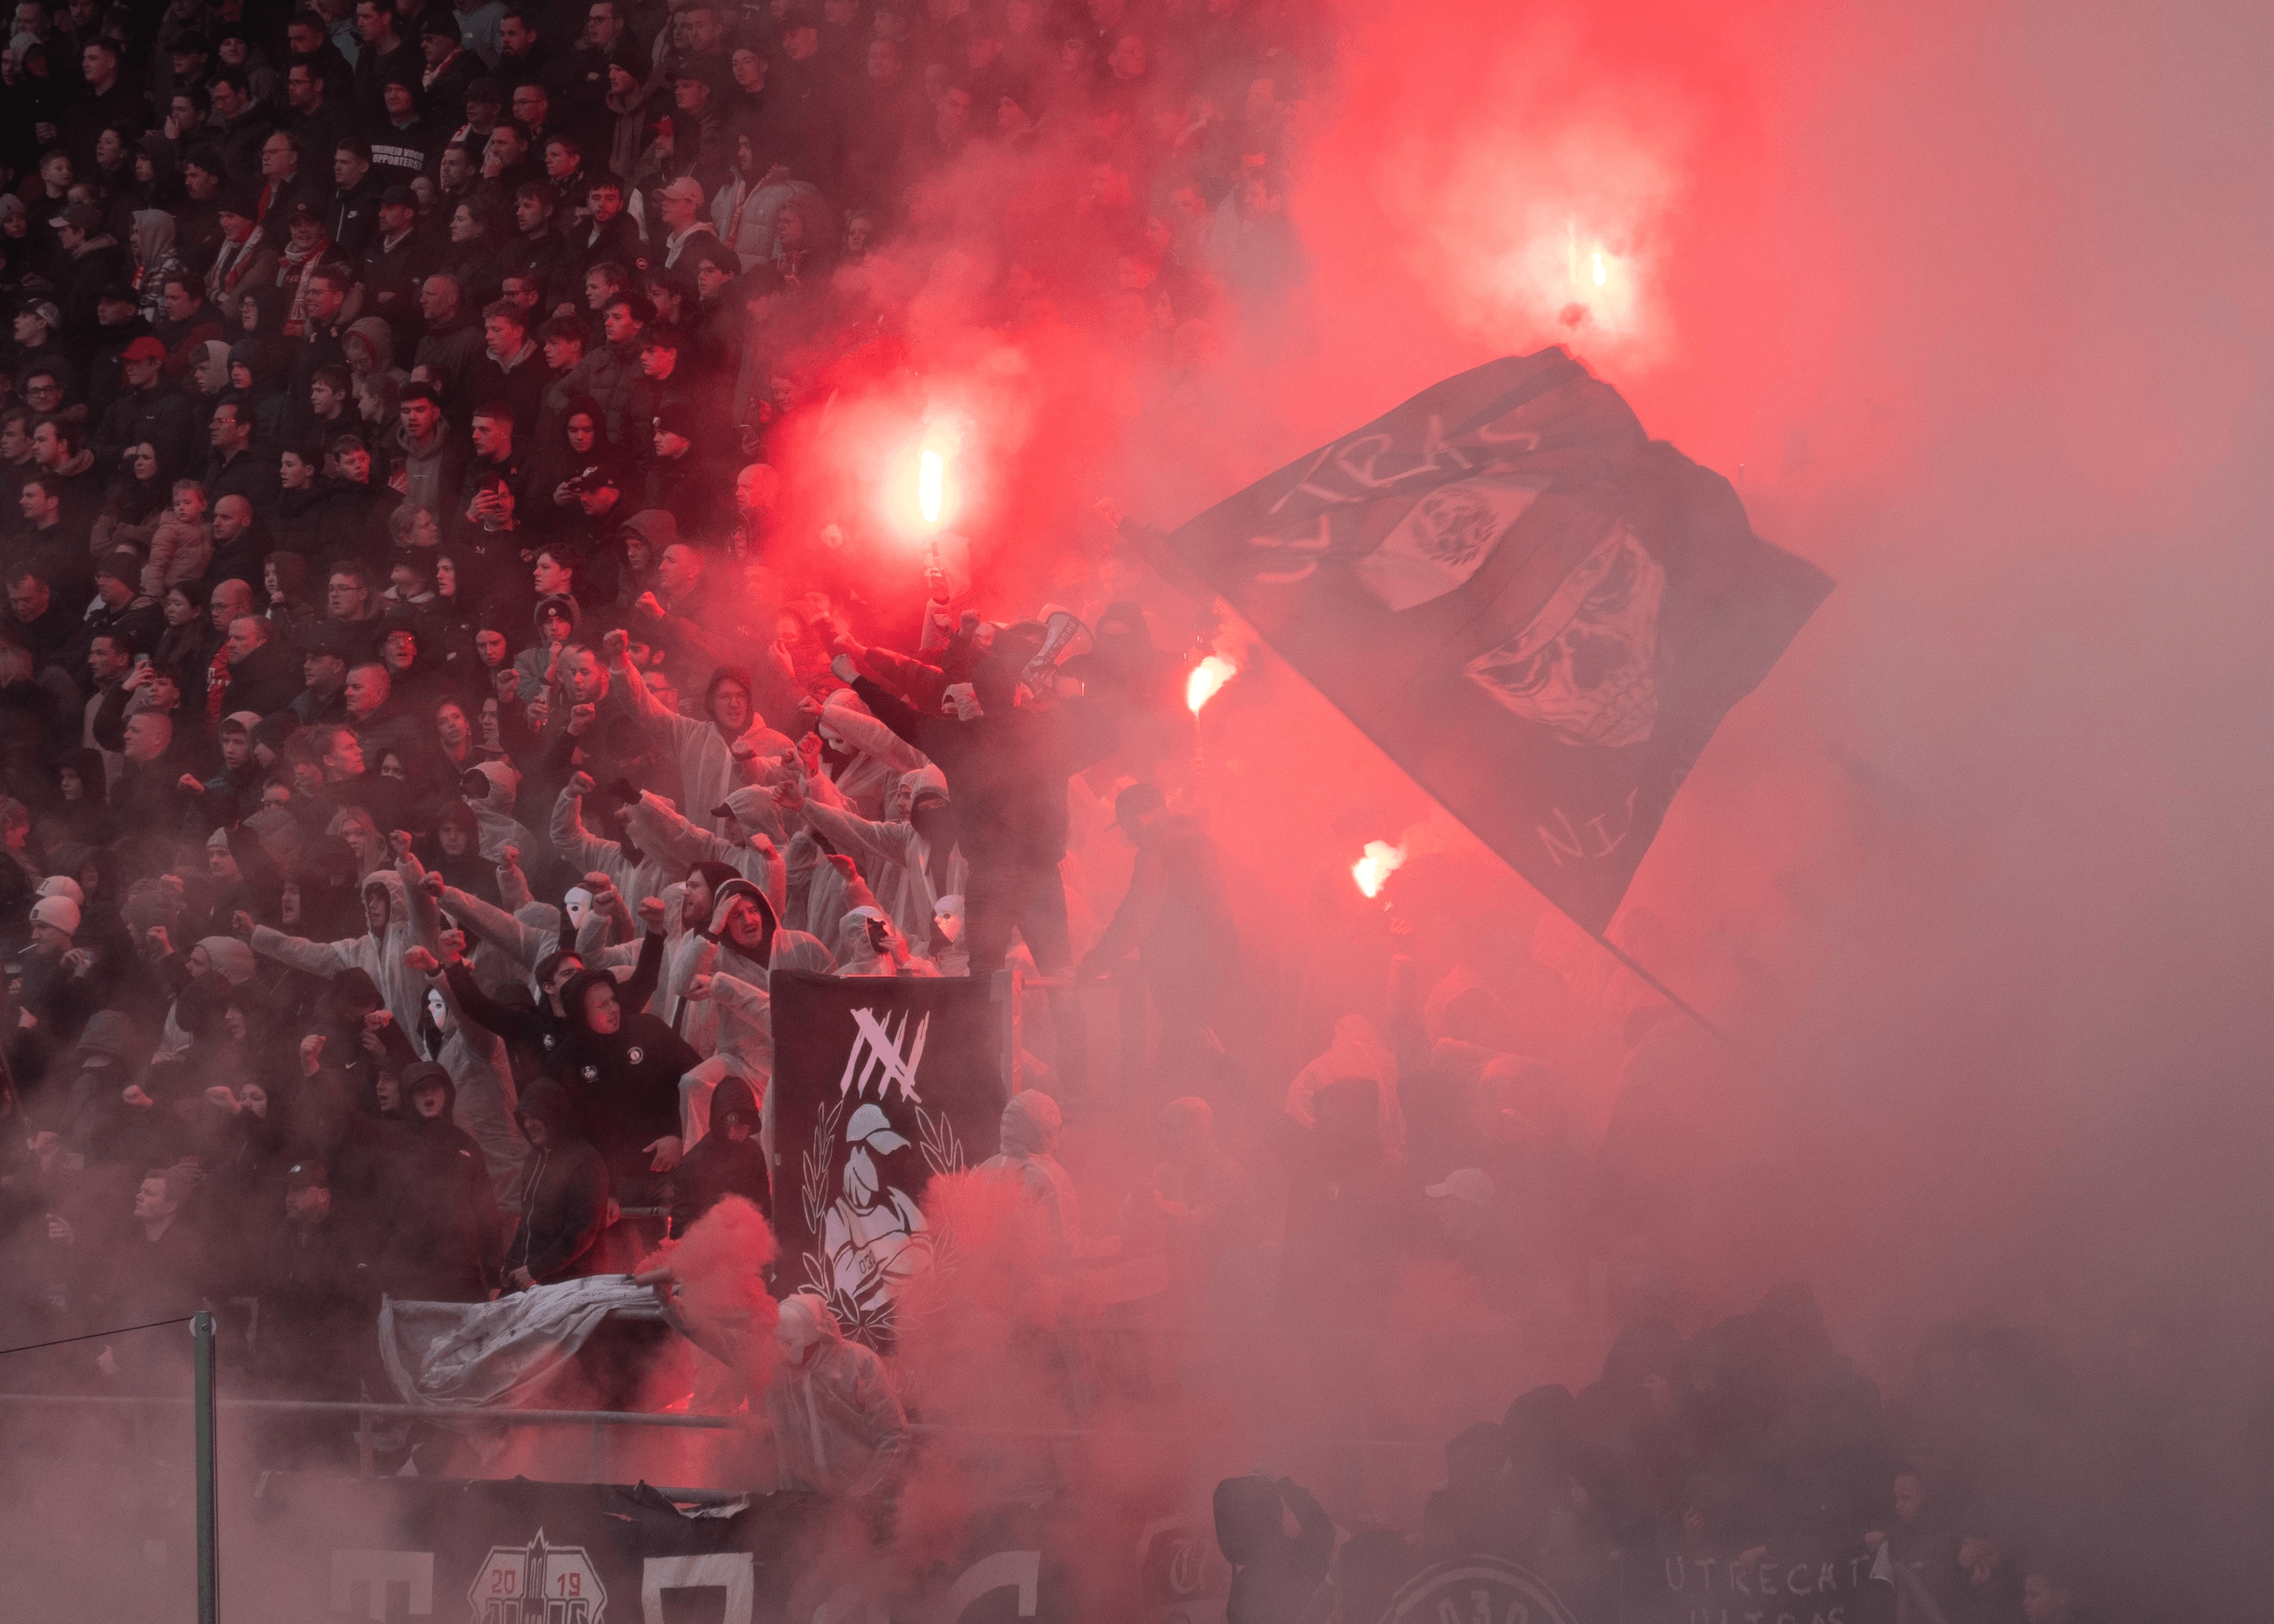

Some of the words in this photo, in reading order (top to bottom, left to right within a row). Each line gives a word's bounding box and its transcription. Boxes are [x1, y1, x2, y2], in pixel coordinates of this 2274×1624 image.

[373, 153, 422, 171] UPPORTERS!
[492, 1569, 516, 1594] 20
[556, 1572, 581, 1597] 19
[1664, 1554, 1870, 1595] UTRECHT
